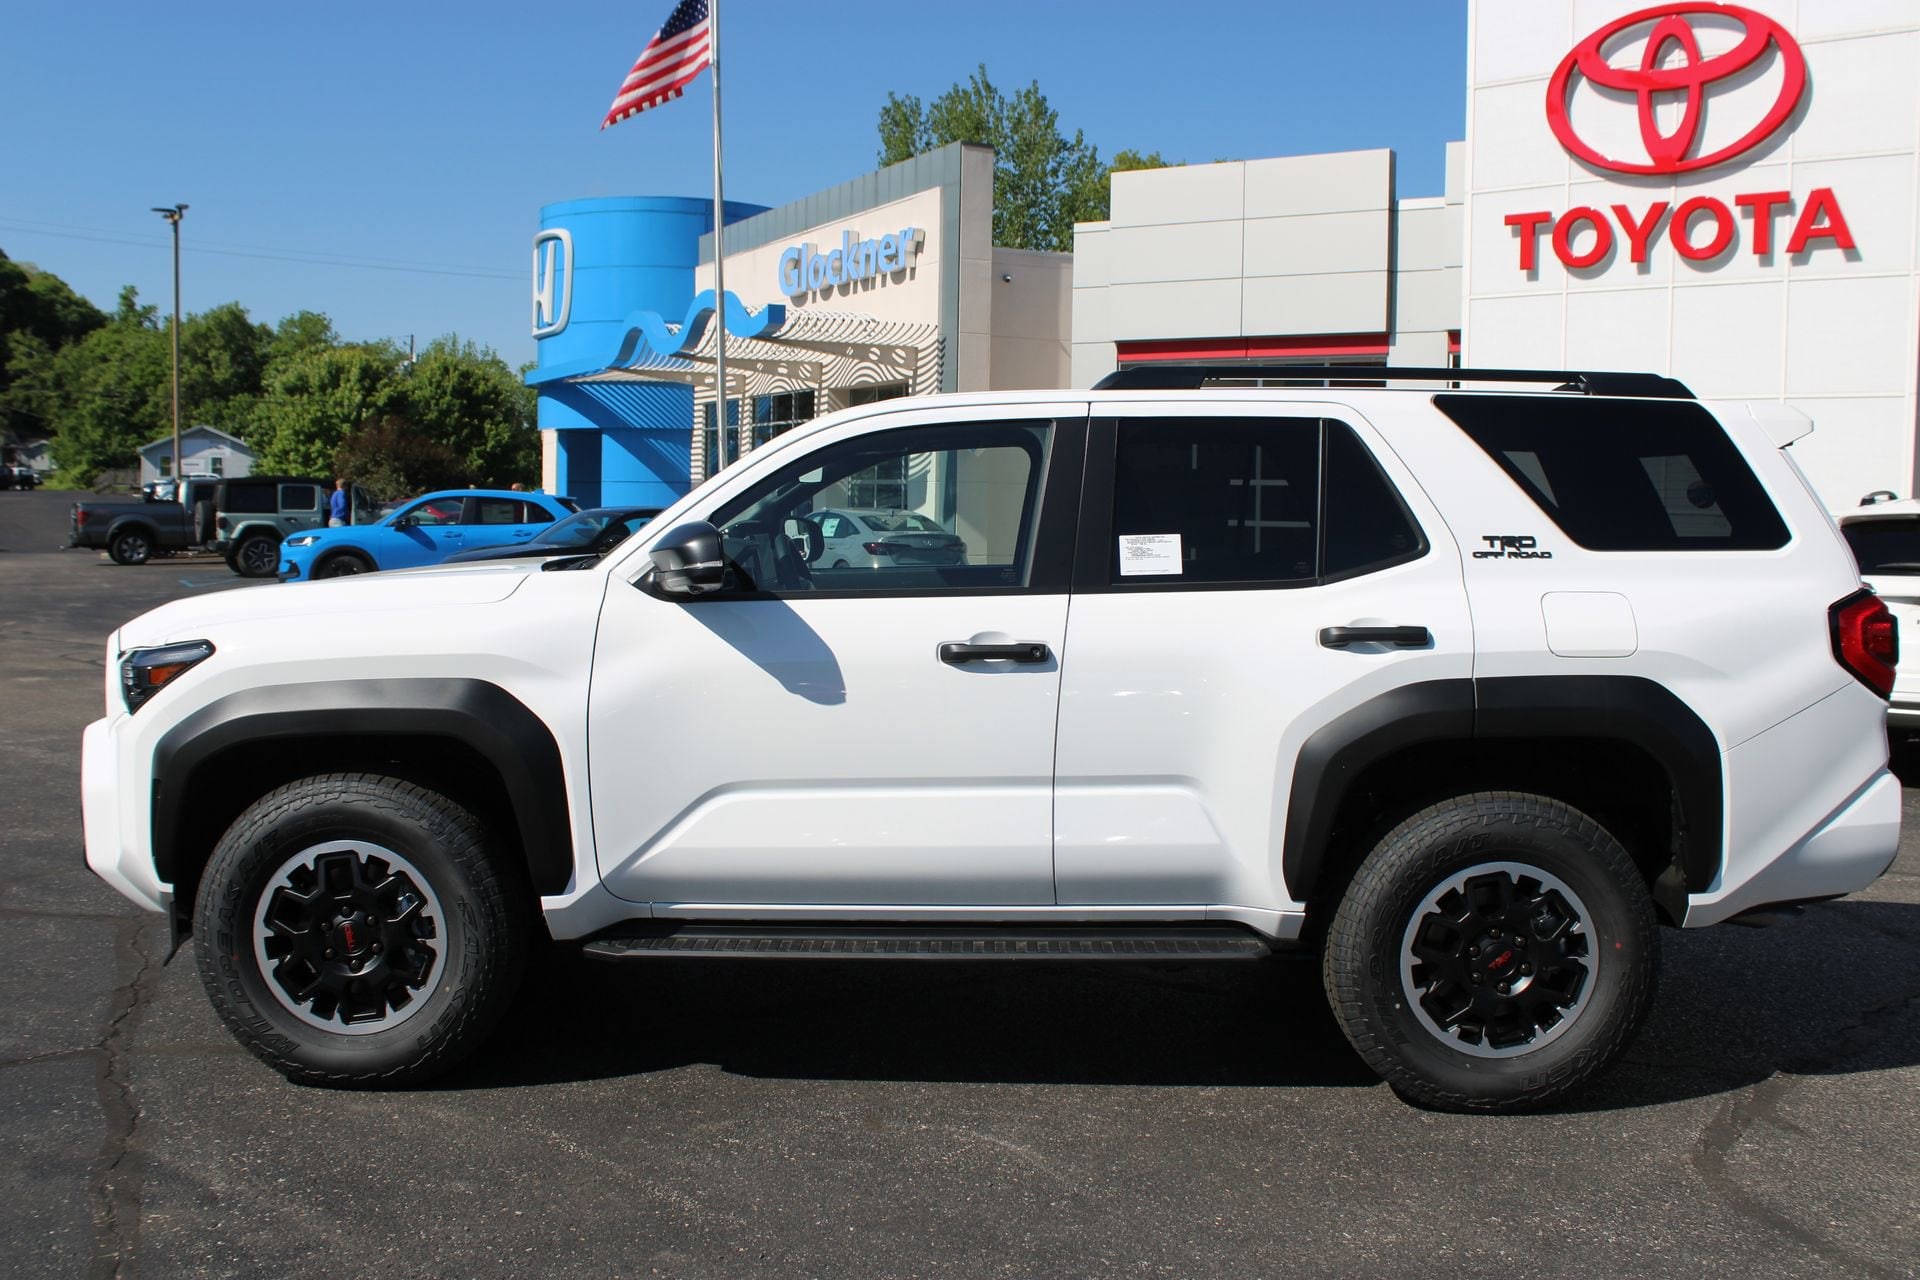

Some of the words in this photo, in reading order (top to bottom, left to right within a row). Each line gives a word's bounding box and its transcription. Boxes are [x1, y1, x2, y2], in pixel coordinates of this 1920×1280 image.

[1504, 187, 1856, 271] TOYOTA
[778, 226, 925, 297] Glockner
[1482, 535, 1537, 552] TRD
[1472, 551, 1505, 559] OFF
[1507, 551, 1553, 559] ROAD
[1487, 949, 1513, 971] TRD
